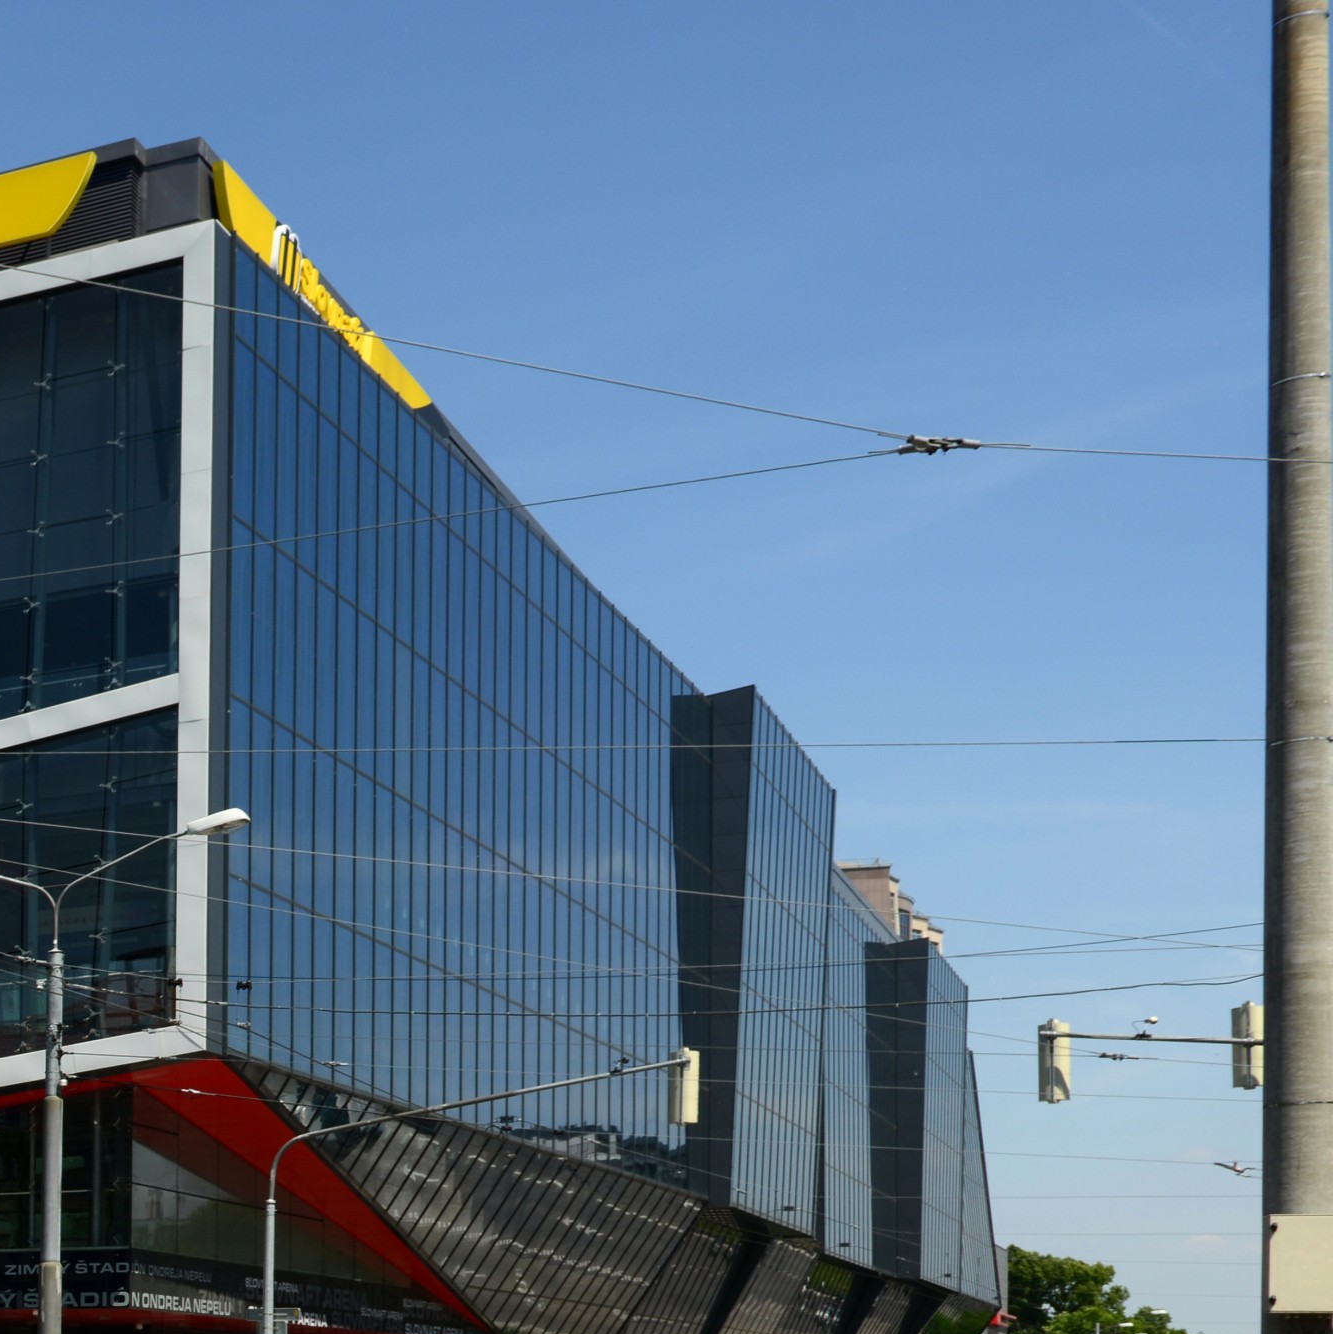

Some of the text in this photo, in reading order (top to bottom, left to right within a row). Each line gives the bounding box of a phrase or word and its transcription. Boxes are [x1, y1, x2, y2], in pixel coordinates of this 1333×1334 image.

[5, 1260, 71, 1275] ZIMÝ
[23, 1288, 140, 1308] ŠADIÓN
[142, 1293, 192, 1312] ONDREJA
[193, 1298, 231, 1316] NEPELU
